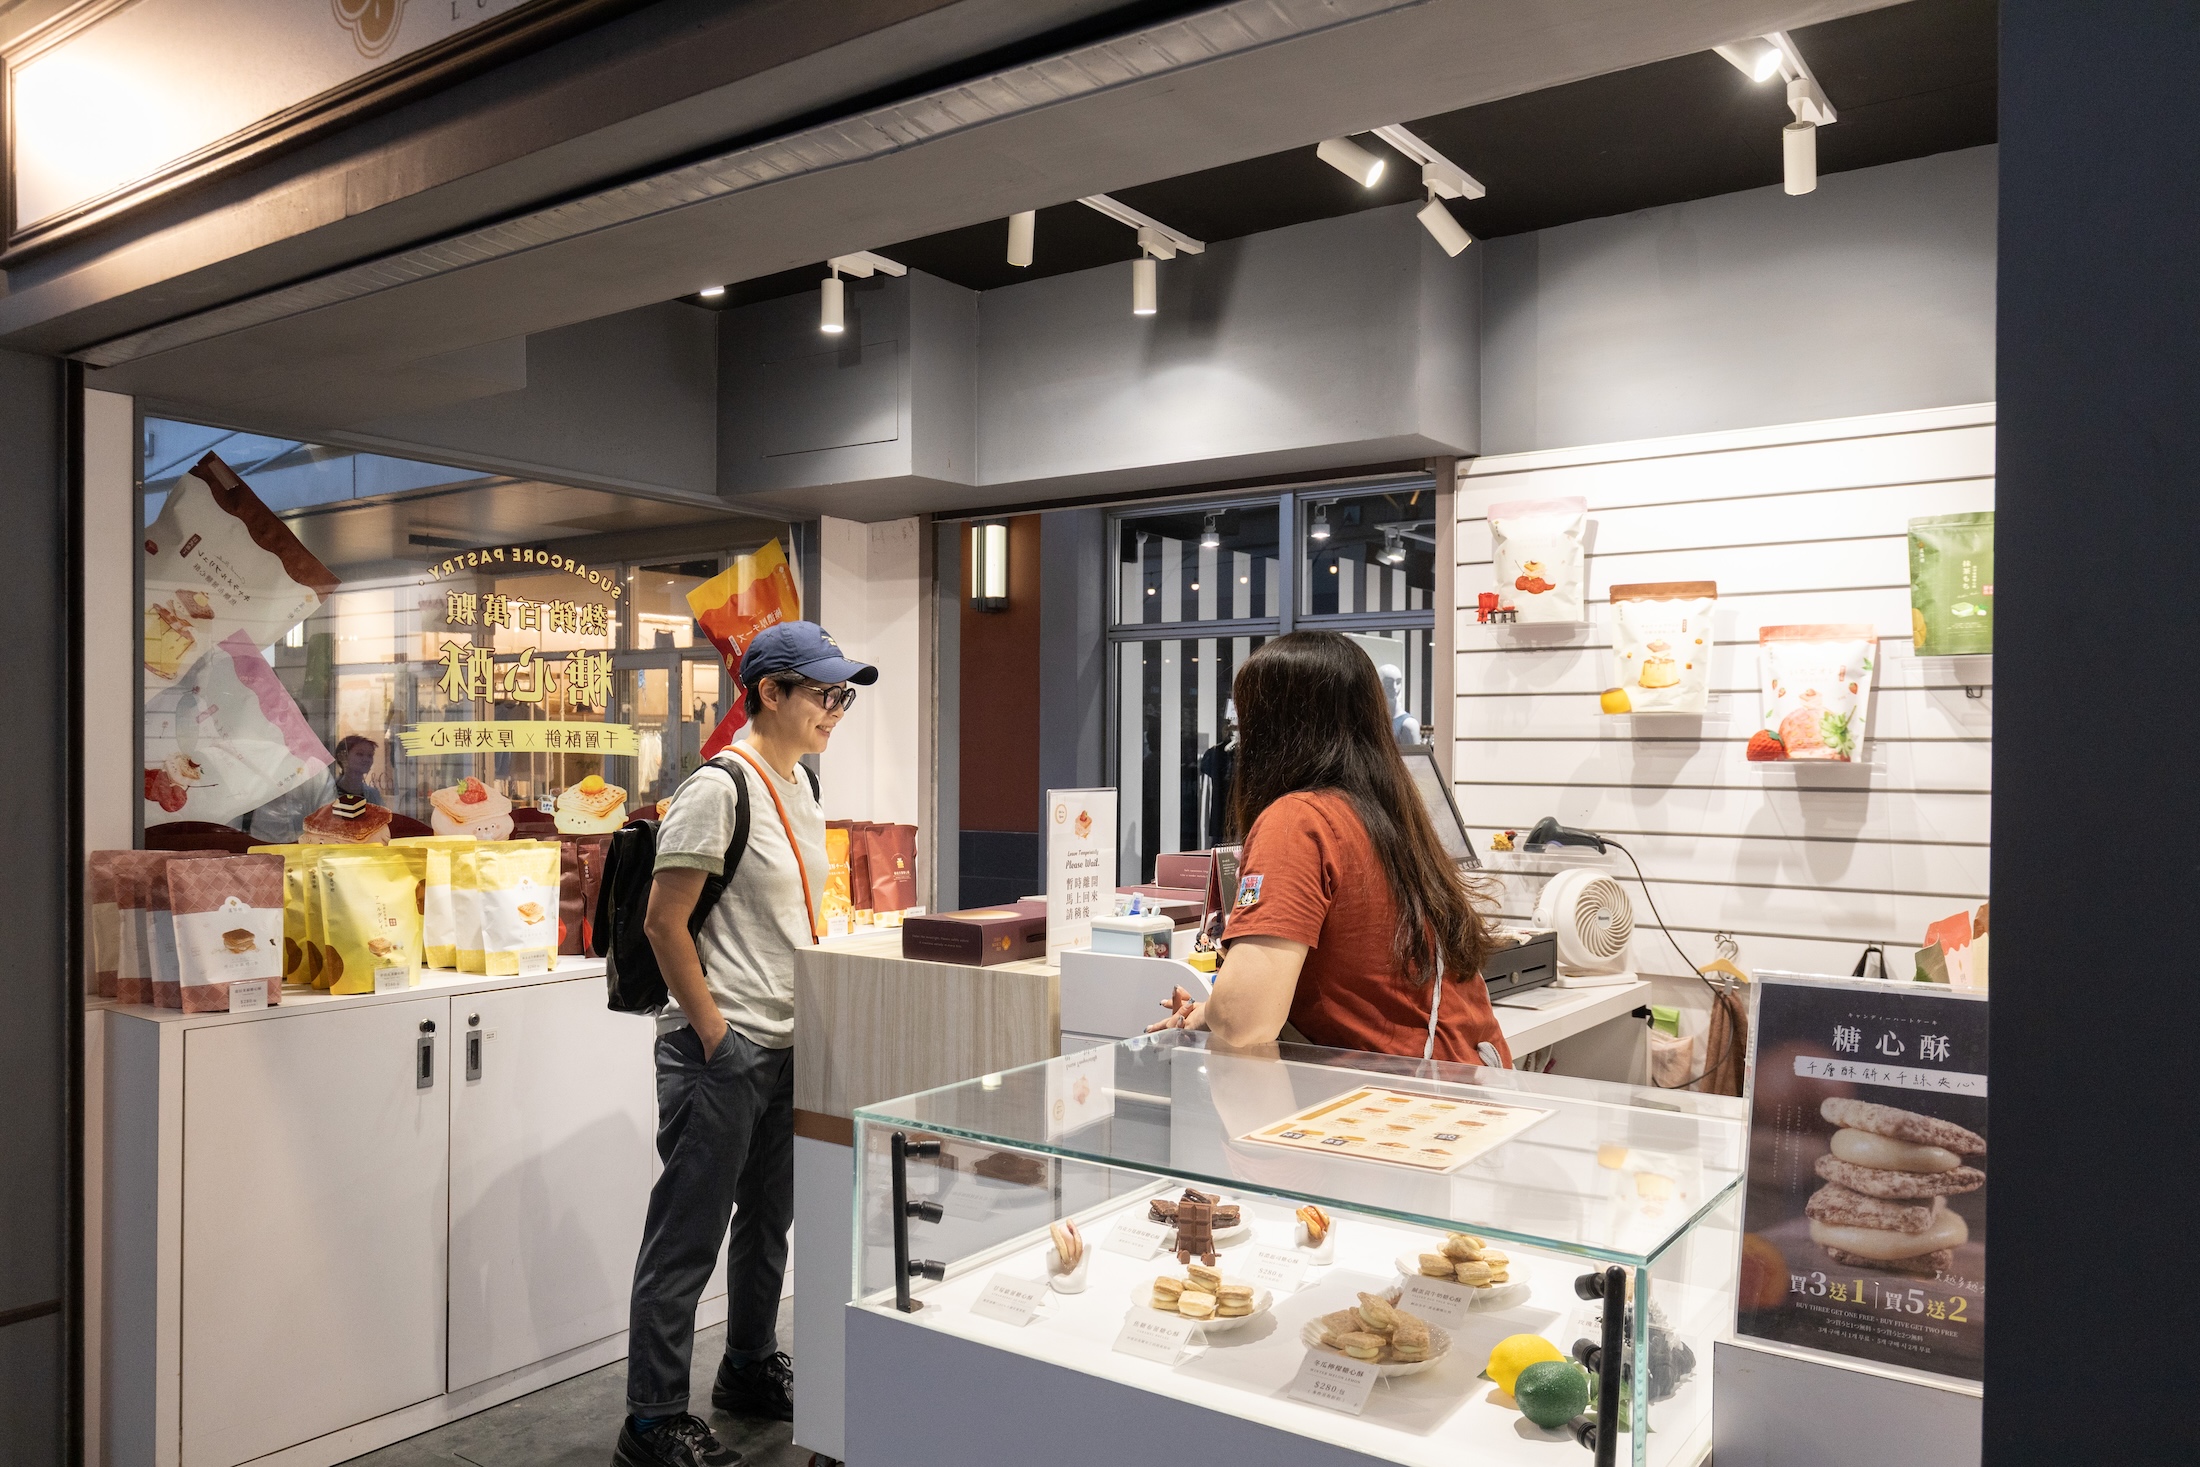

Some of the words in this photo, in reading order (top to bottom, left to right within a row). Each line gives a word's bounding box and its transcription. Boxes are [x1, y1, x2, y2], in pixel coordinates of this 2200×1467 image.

[1065, 860, 1083, 869] Please
[1066, 875, 1099, 890] 暫時離開
[1066, 890, 1098, 905] 馬上回來
[1848, 1012, 1938, 1026] キャンディーハートケーキ
[1832, 1024, 1950, 1062] 糖心酥
[1789, 1271, 1866, 1304] 買3送1
[1885, 1288, 1968, 1323] 買5送2
[1809, 1304, 1830, 1314] THREE
[1831, 1307, 1844, 1316] GET
[1844, 1310, 1858, 1319] ONE
[1858, 1313, 1875, 1322] FREE
[1880, 1317, 1894, 1326] BUY
[1894, 1320, 1910, 1329] FIVE
[1910, 1323, 1924, 1331] GET
[1924, 1326, 1940, 1335] TWO
[1941, 1329, 1958, 1338] FREE
[1310, 1368, 1327, 1376] WINTER
[1314, 1360, 1364, 1378] 冬瓜檸檬糖心酥
